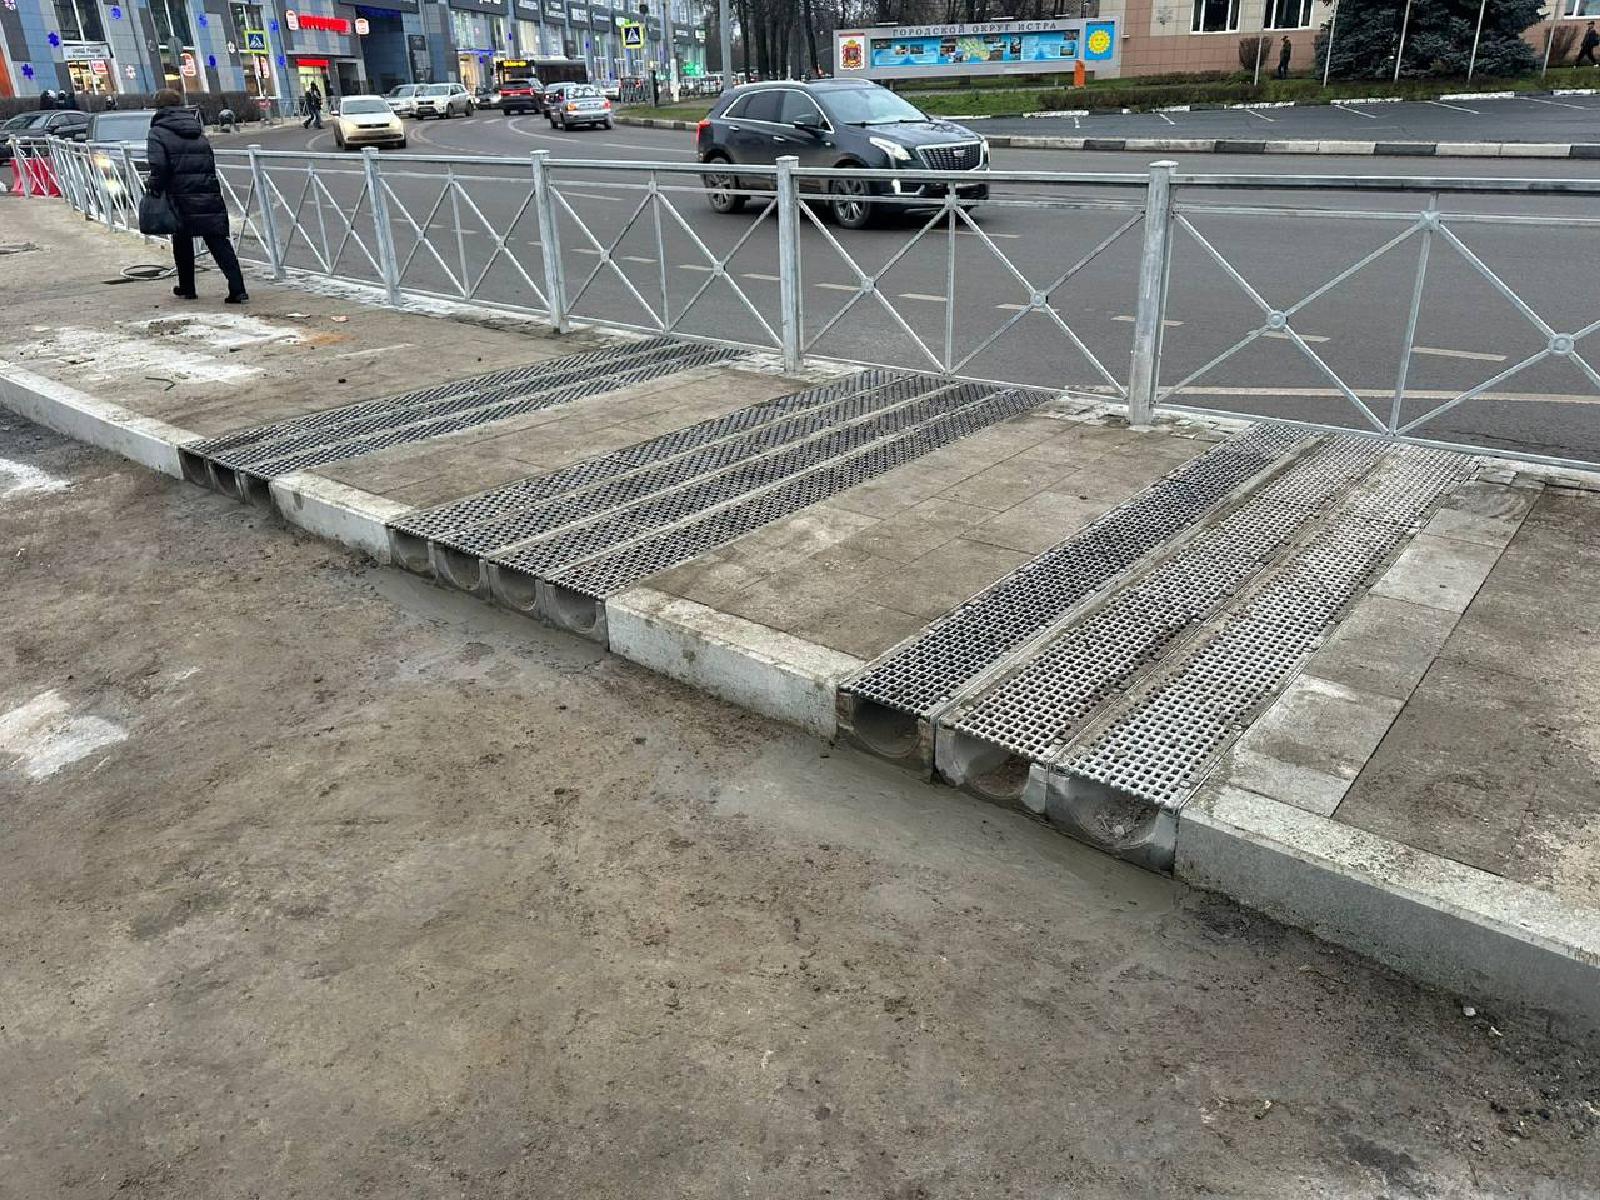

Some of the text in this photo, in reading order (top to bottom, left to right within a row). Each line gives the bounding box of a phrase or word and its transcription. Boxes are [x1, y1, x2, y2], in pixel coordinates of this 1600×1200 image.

[892, 22, 1057, 37] ГОРОДСКОЙ ОКРУГ ИСТРА
